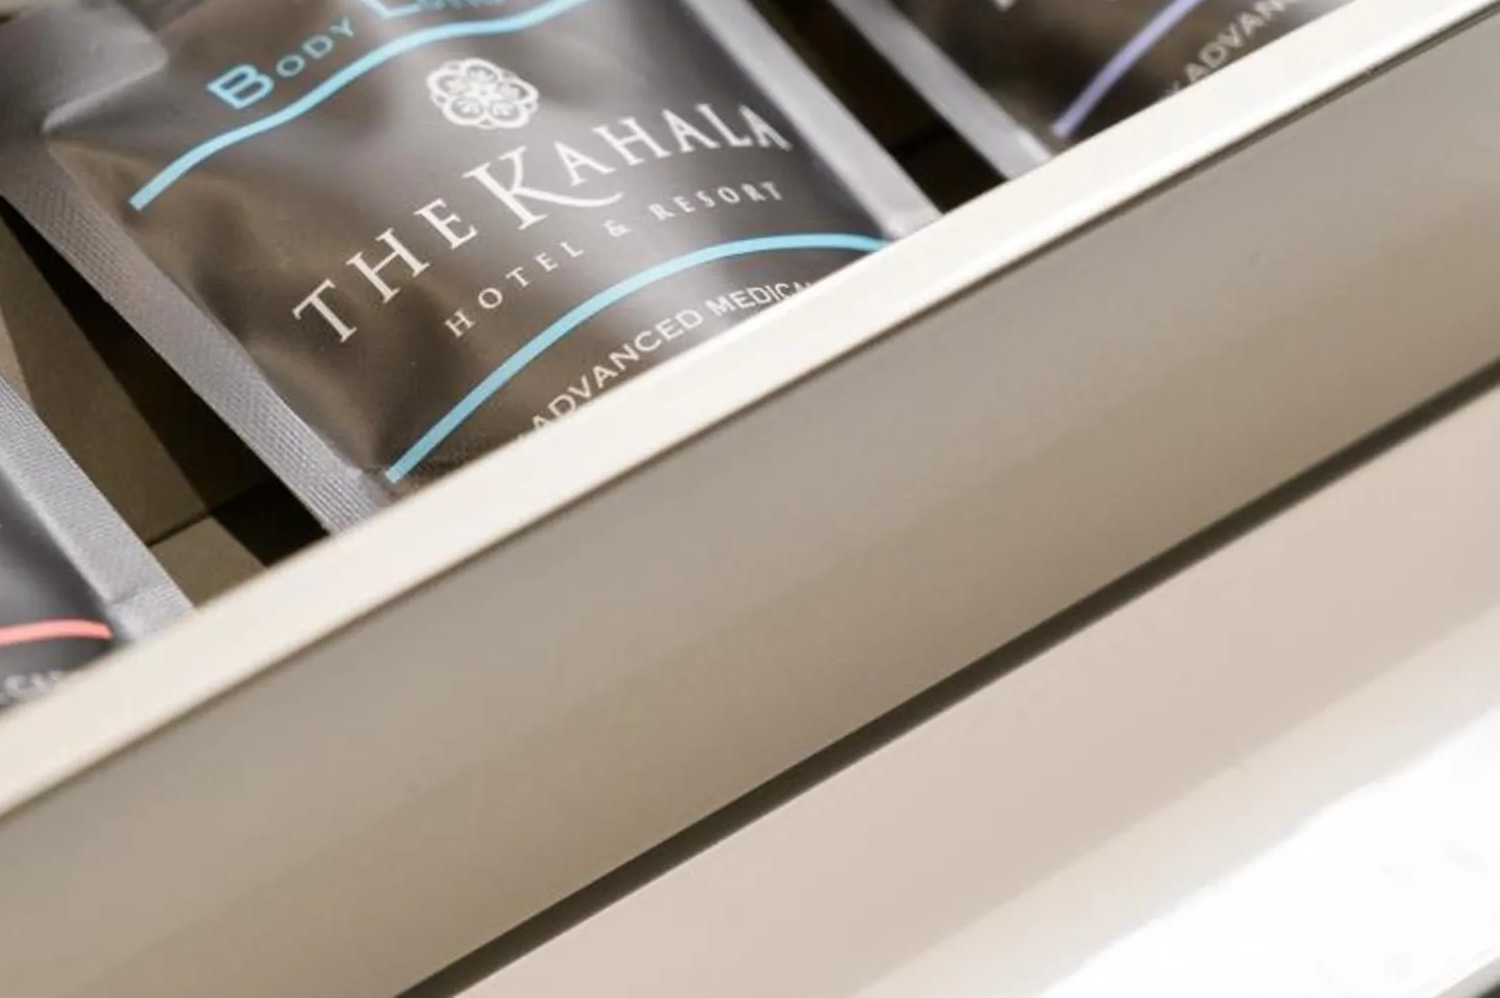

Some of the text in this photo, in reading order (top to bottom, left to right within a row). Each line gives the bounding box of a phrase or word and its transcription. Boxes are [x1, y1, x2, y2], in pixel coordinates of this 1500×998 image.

[206, 16, 355, 109] BODY
[293, 103, 793, 345] THE KAHALA
[444, 180, 784, 339] HOTEL & RESORT
[529, 309, 704, 433] ADVANCED
